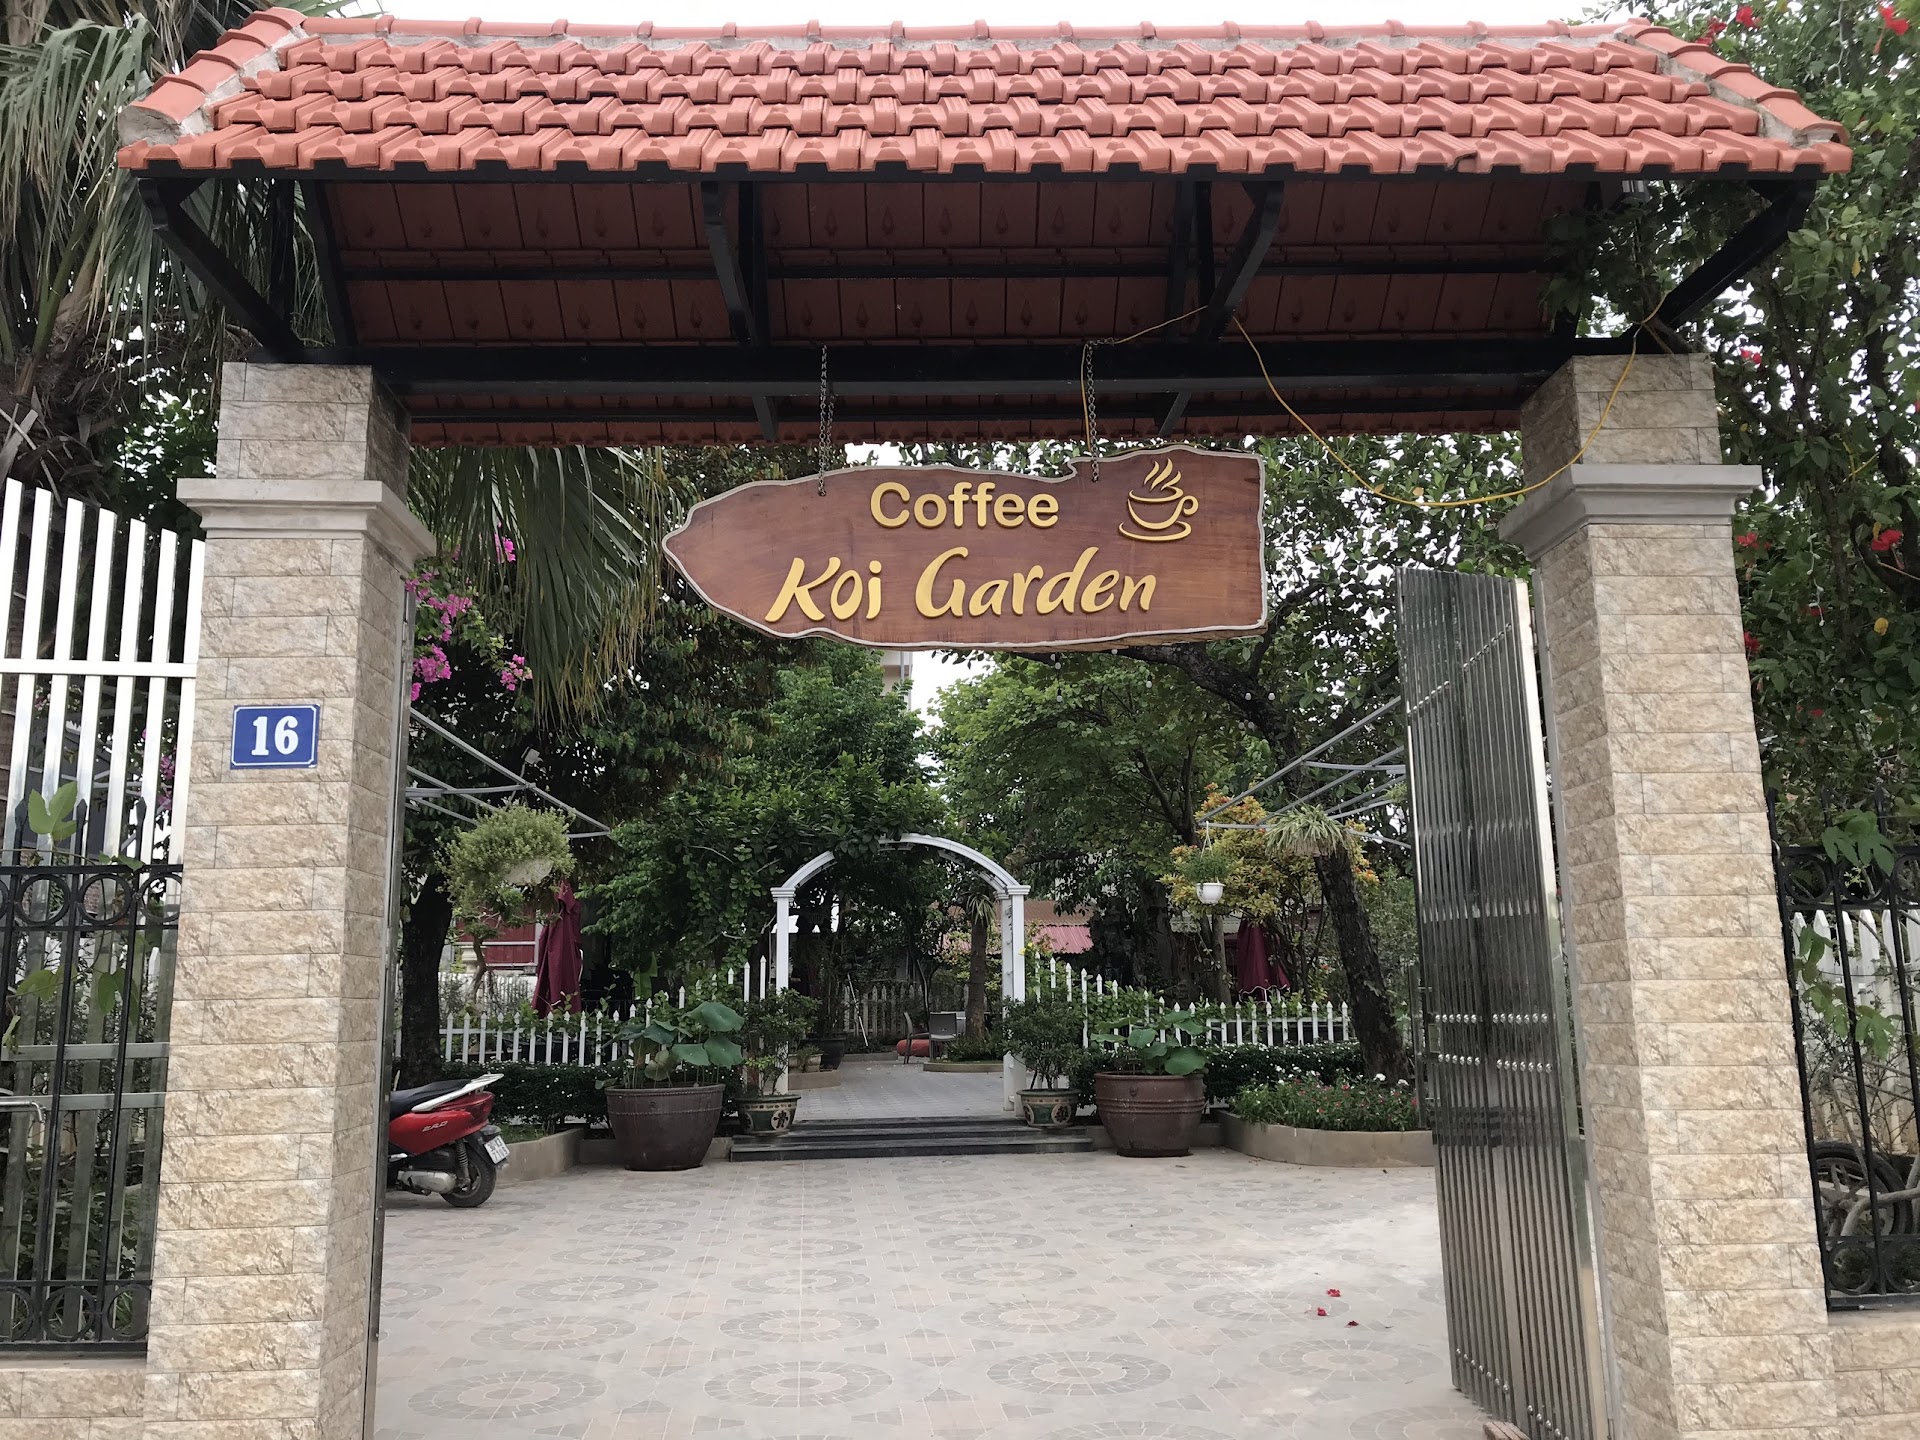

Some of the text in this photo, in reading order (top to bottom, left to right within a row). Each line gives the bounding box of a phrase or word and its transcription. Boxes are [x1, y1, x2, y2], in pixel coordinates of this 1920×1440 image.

[870, 481, 1059, 527] Coffee
[765, 546, 1157, 622] Koi Garden
[251, 715, 299, 756] 16
